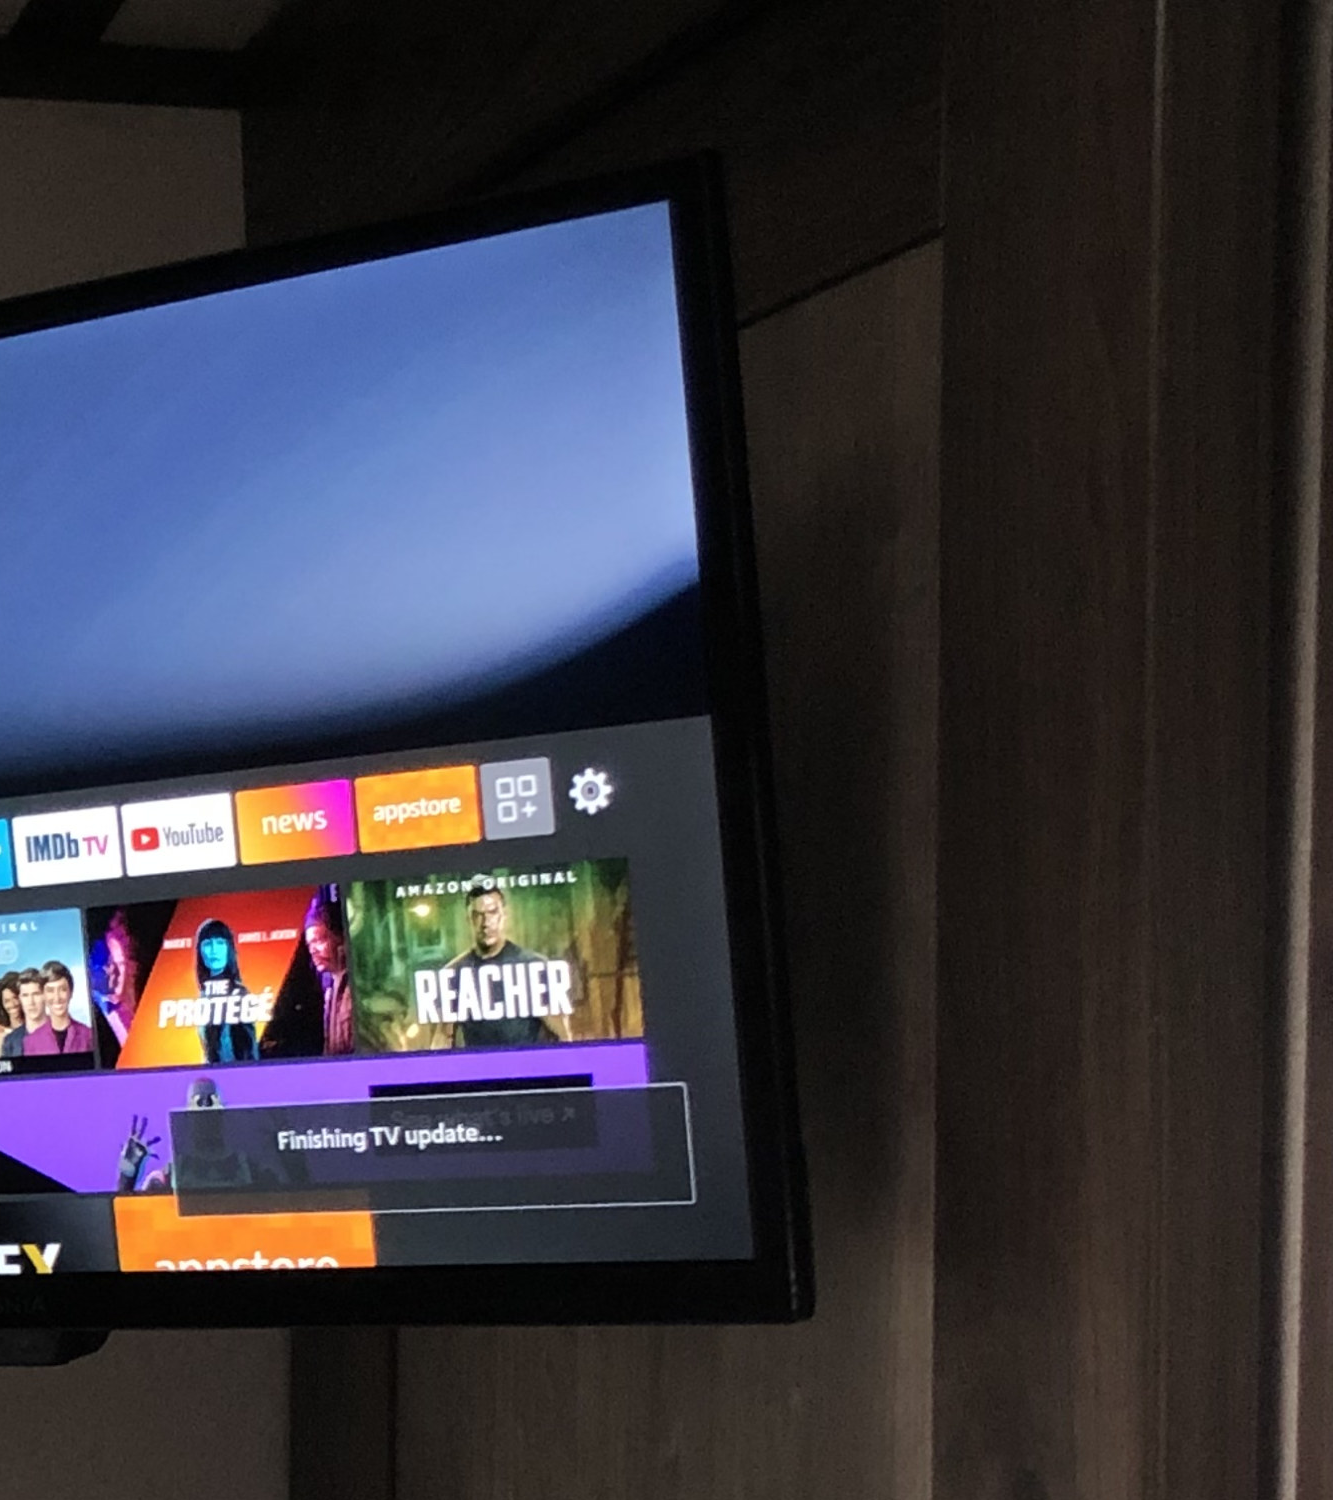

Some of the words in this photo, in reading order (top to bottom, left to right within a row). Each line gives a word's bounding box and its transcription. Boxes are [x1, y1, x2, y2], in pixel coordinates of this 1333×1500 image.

[261, 808, 328, 835] news
[373, 795, 462, 824] appstore
[25, 832, 80, 863] IMDb
[83, 834, 109, 857] TV
[163, 820, 224, 846] YouTube
[395, 880, 472, 899] AMAZON
[481, 870, 578, 891] ORIGINAL
[203, 978, 230, 996] THE
[413, 959, 576, 1025] REACHER
[277, 1127, 367, 1153] Finishing
[369, 1126, 401, 1147] TV
[405, 1121, 504, 1151] update...
